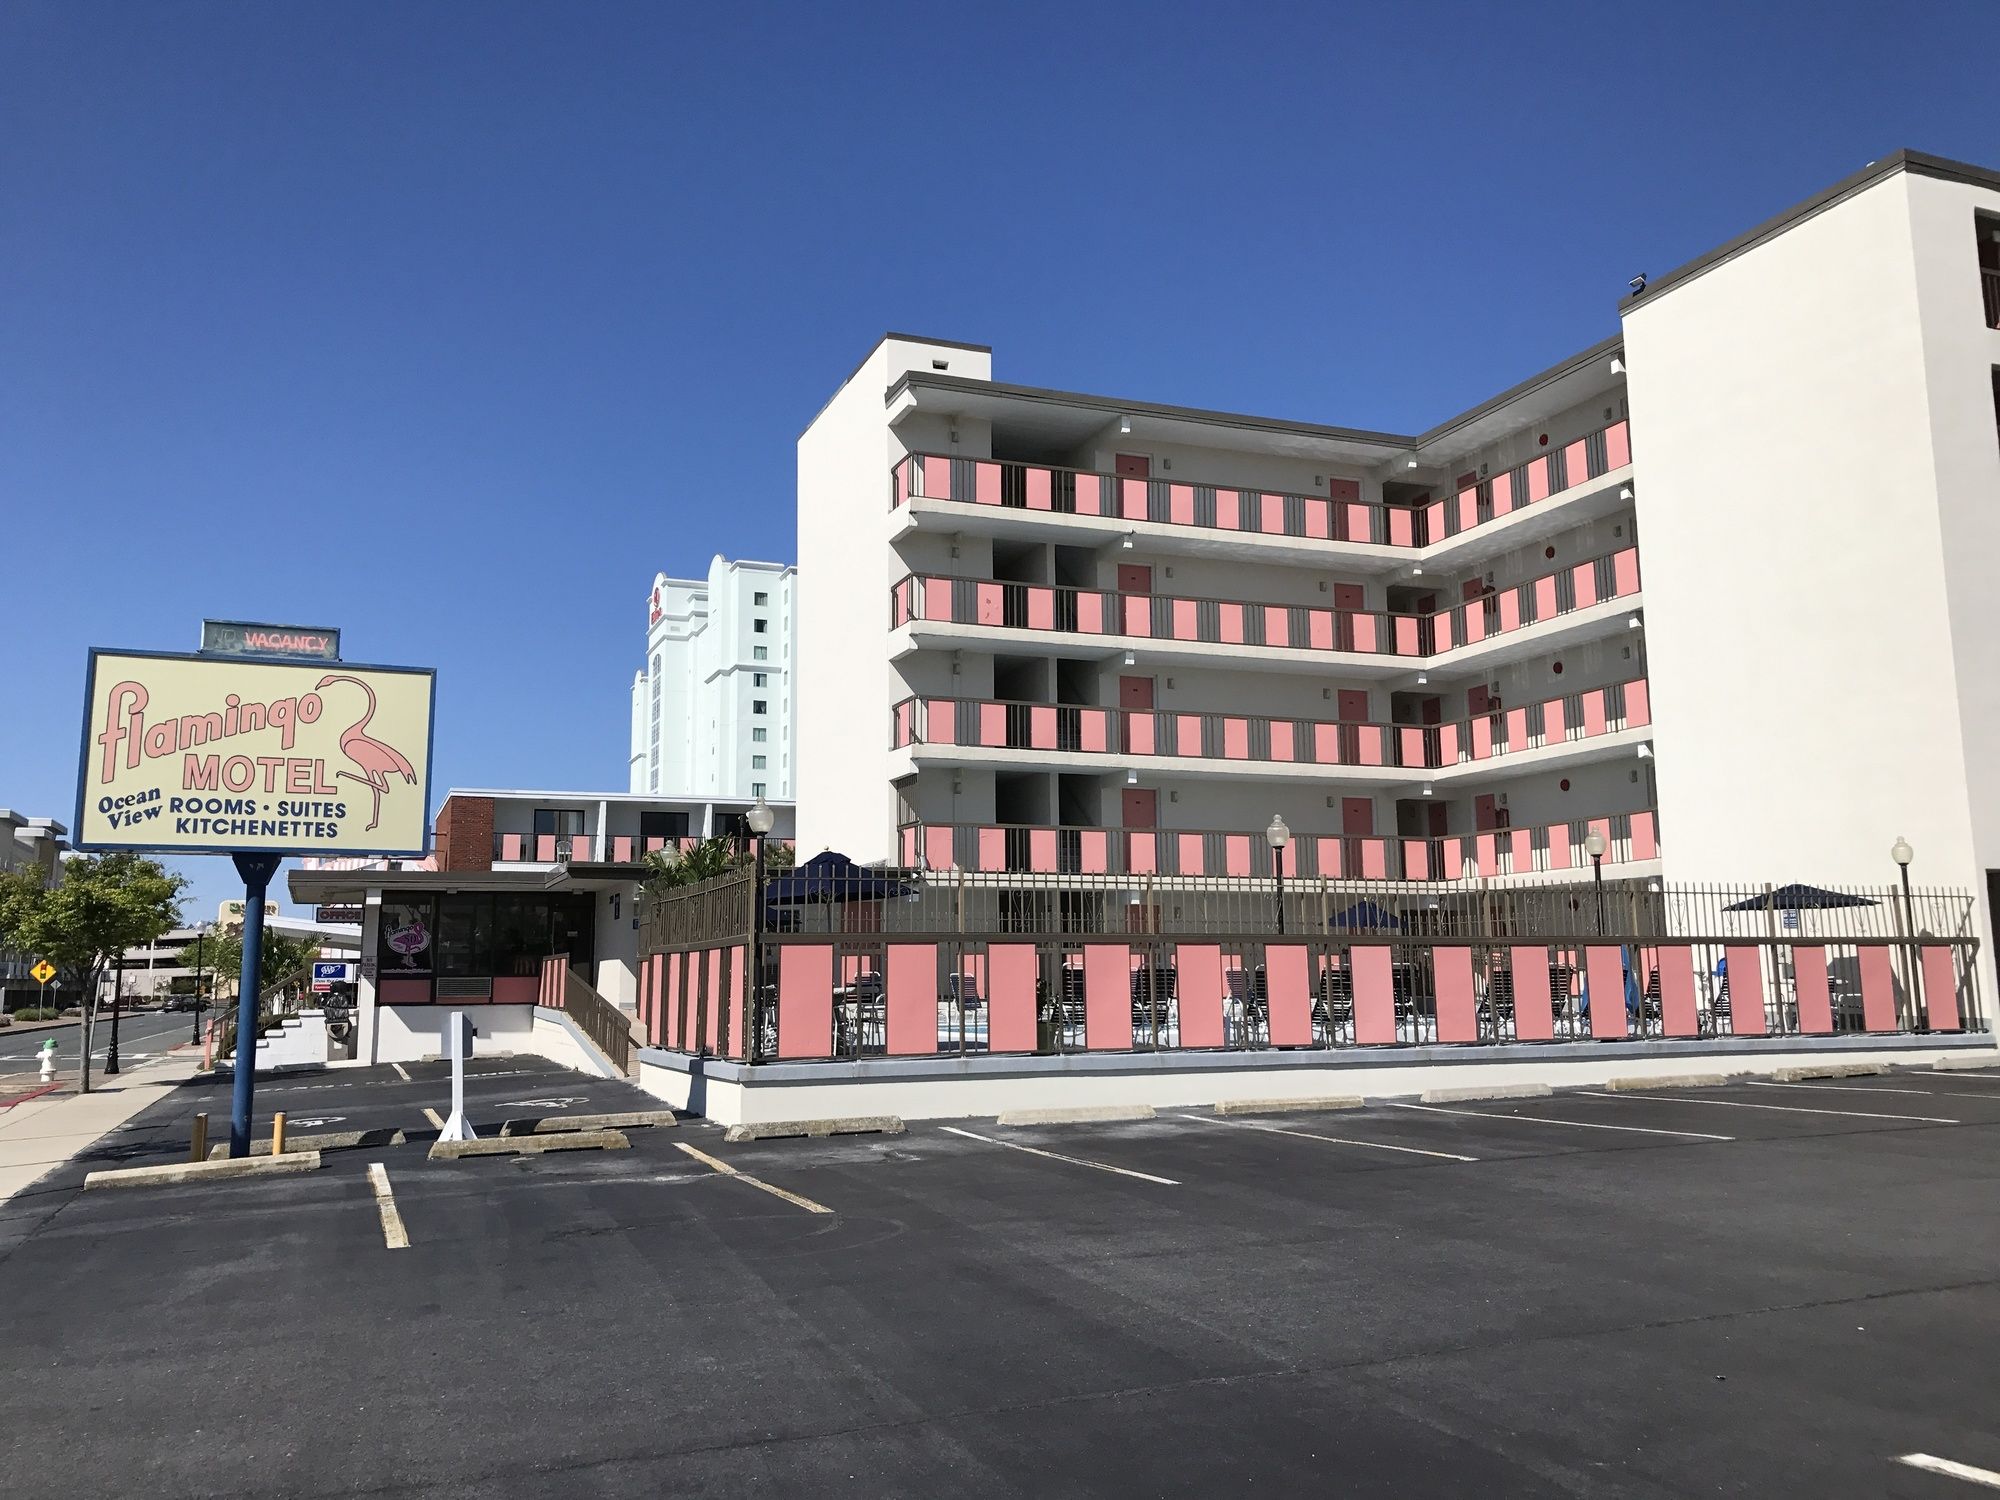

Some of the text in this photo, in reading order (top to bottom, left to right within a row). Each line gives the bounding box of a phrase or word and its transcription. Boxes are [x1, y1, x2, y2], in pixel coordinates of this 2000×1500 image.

[245, 631, 329, 650] VACANCY
[182, 753, 338, 795] MOTEL
[98, 788, 161, 814] Ocean
[169, 797, 347, 819] ROOMS SUITES
[107, 805, 163, 830] View
[176, 818, 338, 838] KITCHENETTES
[320, 910, 361, 920] OFFICE
